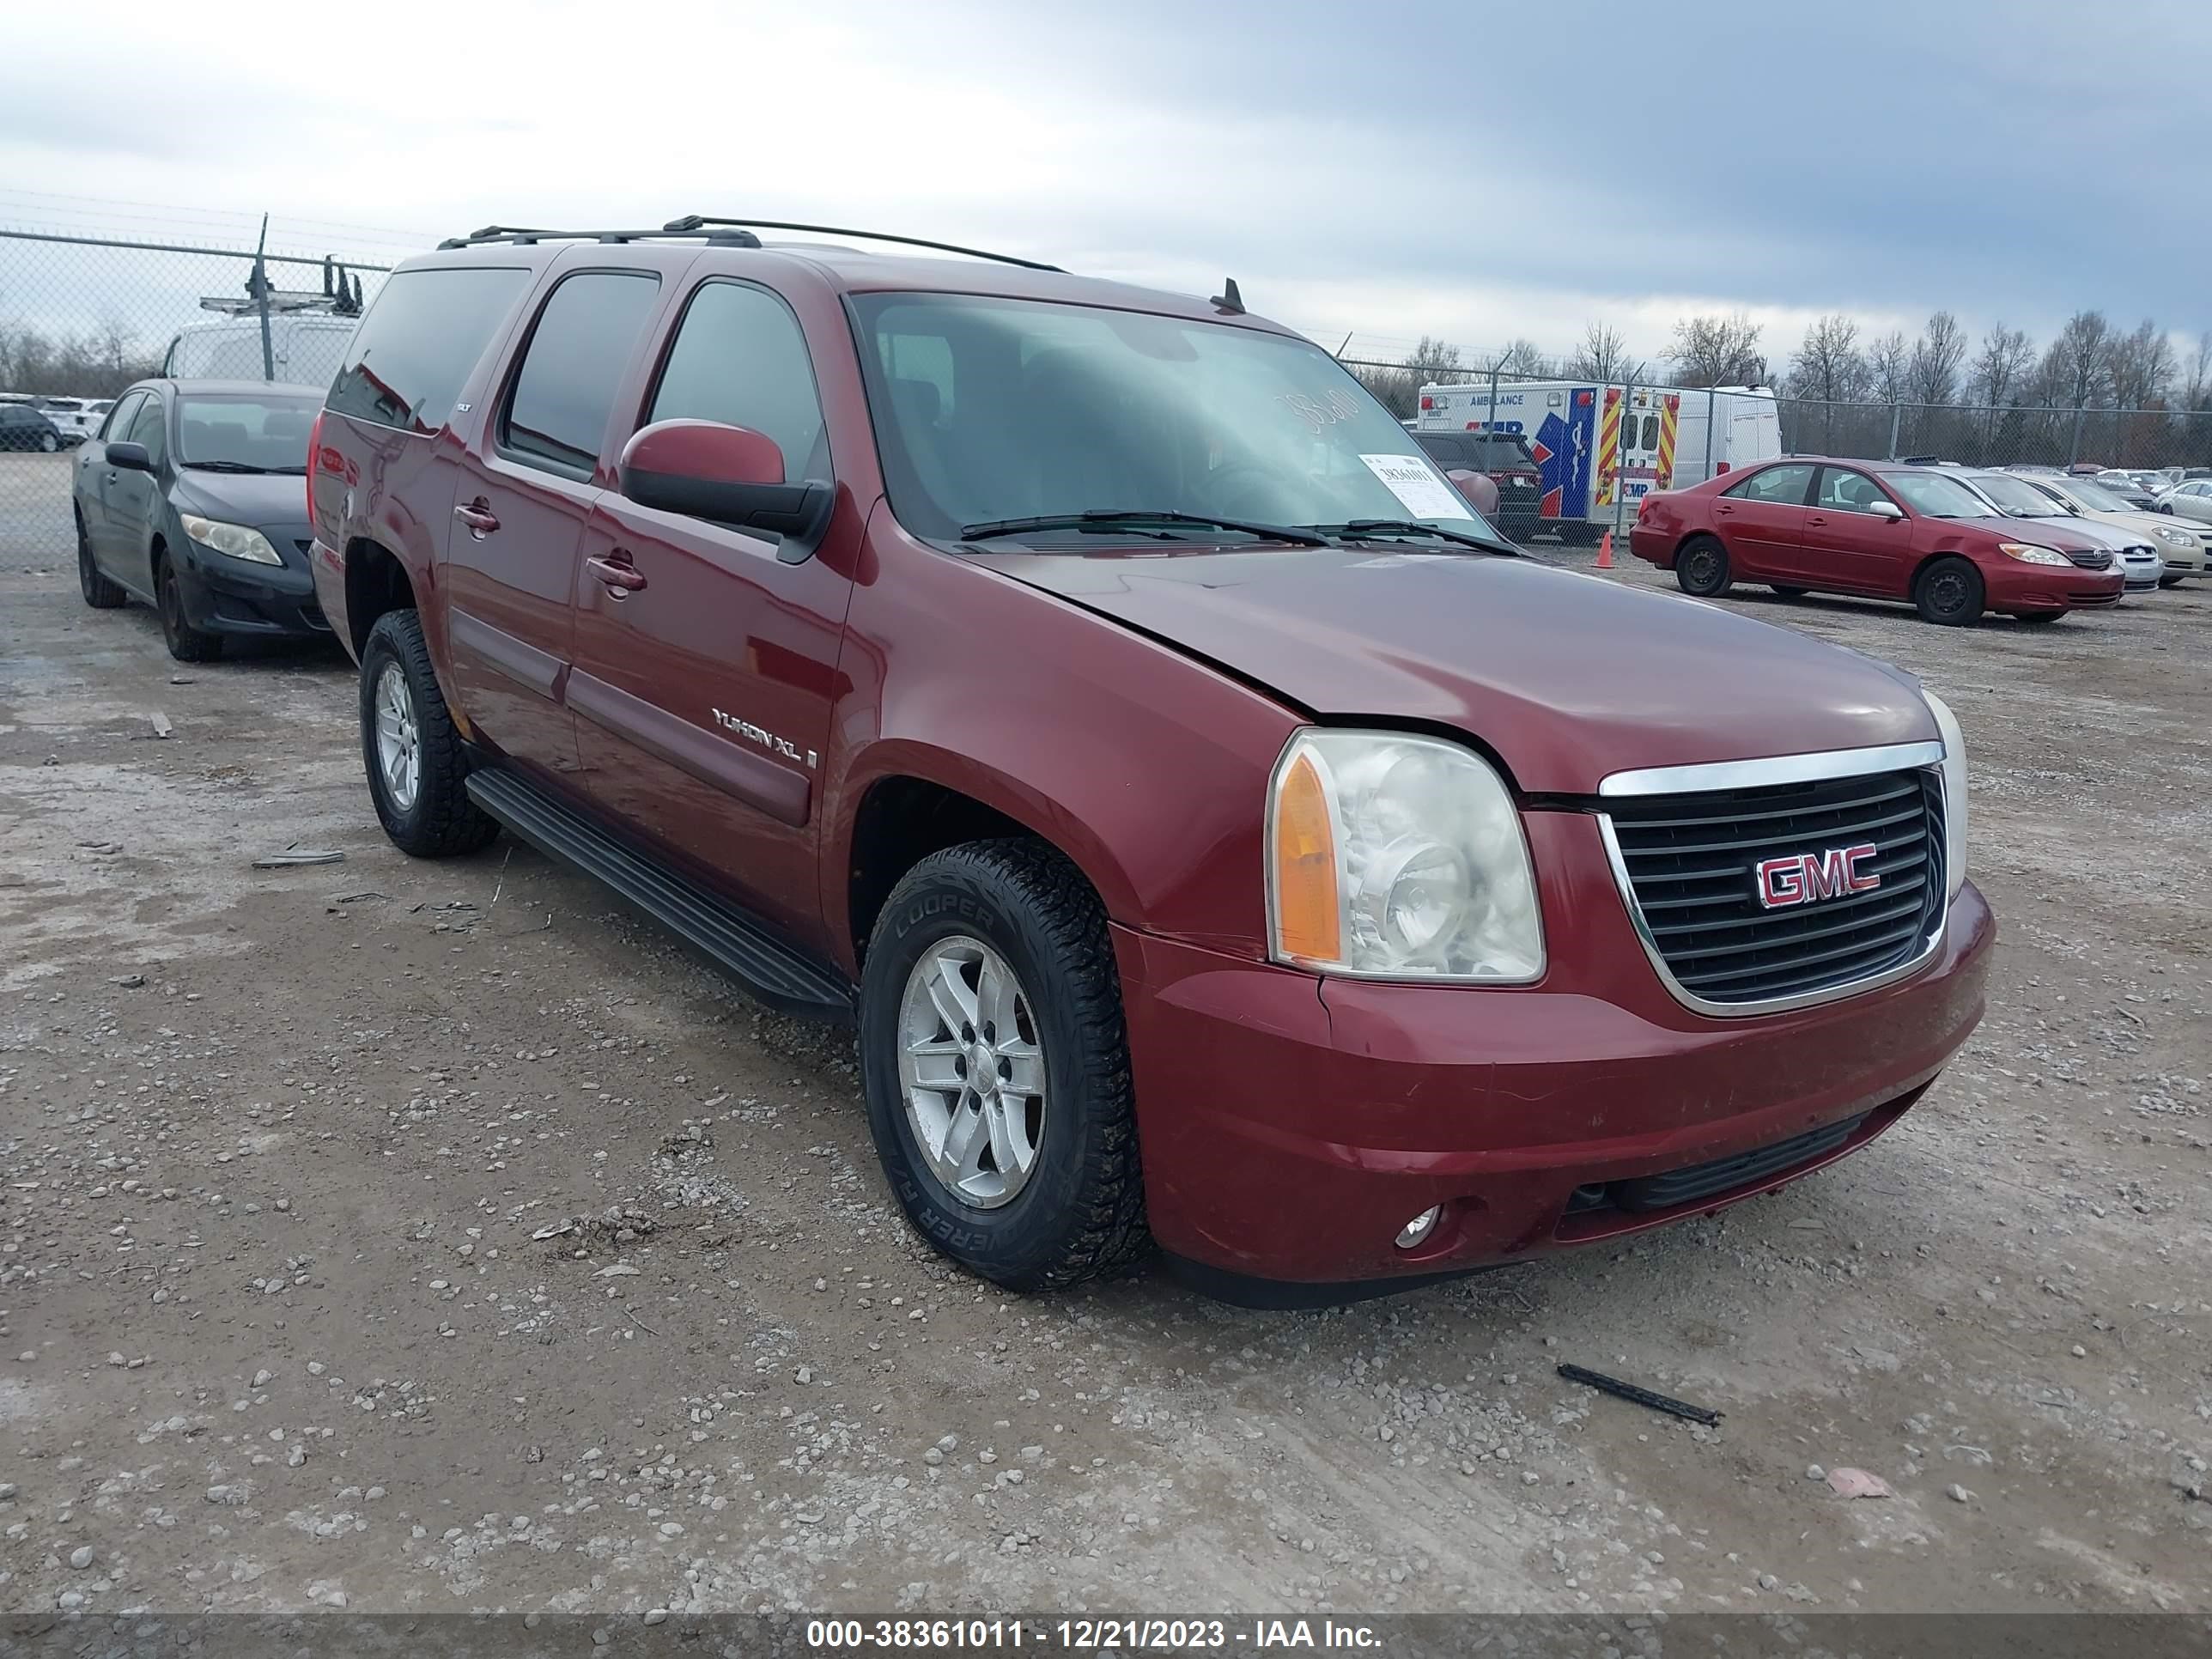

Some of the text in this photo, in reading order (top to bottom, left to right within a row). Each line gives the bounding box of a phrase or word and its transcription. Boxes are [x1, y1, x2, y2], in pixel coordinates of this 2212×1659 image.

[1379, 468, 1433, 482] 38361011
[712, 708, 802, 762] YUKON XL
[1756, 842, 1881, 909] GMC
[896, 893, 994, 939] COOPER
